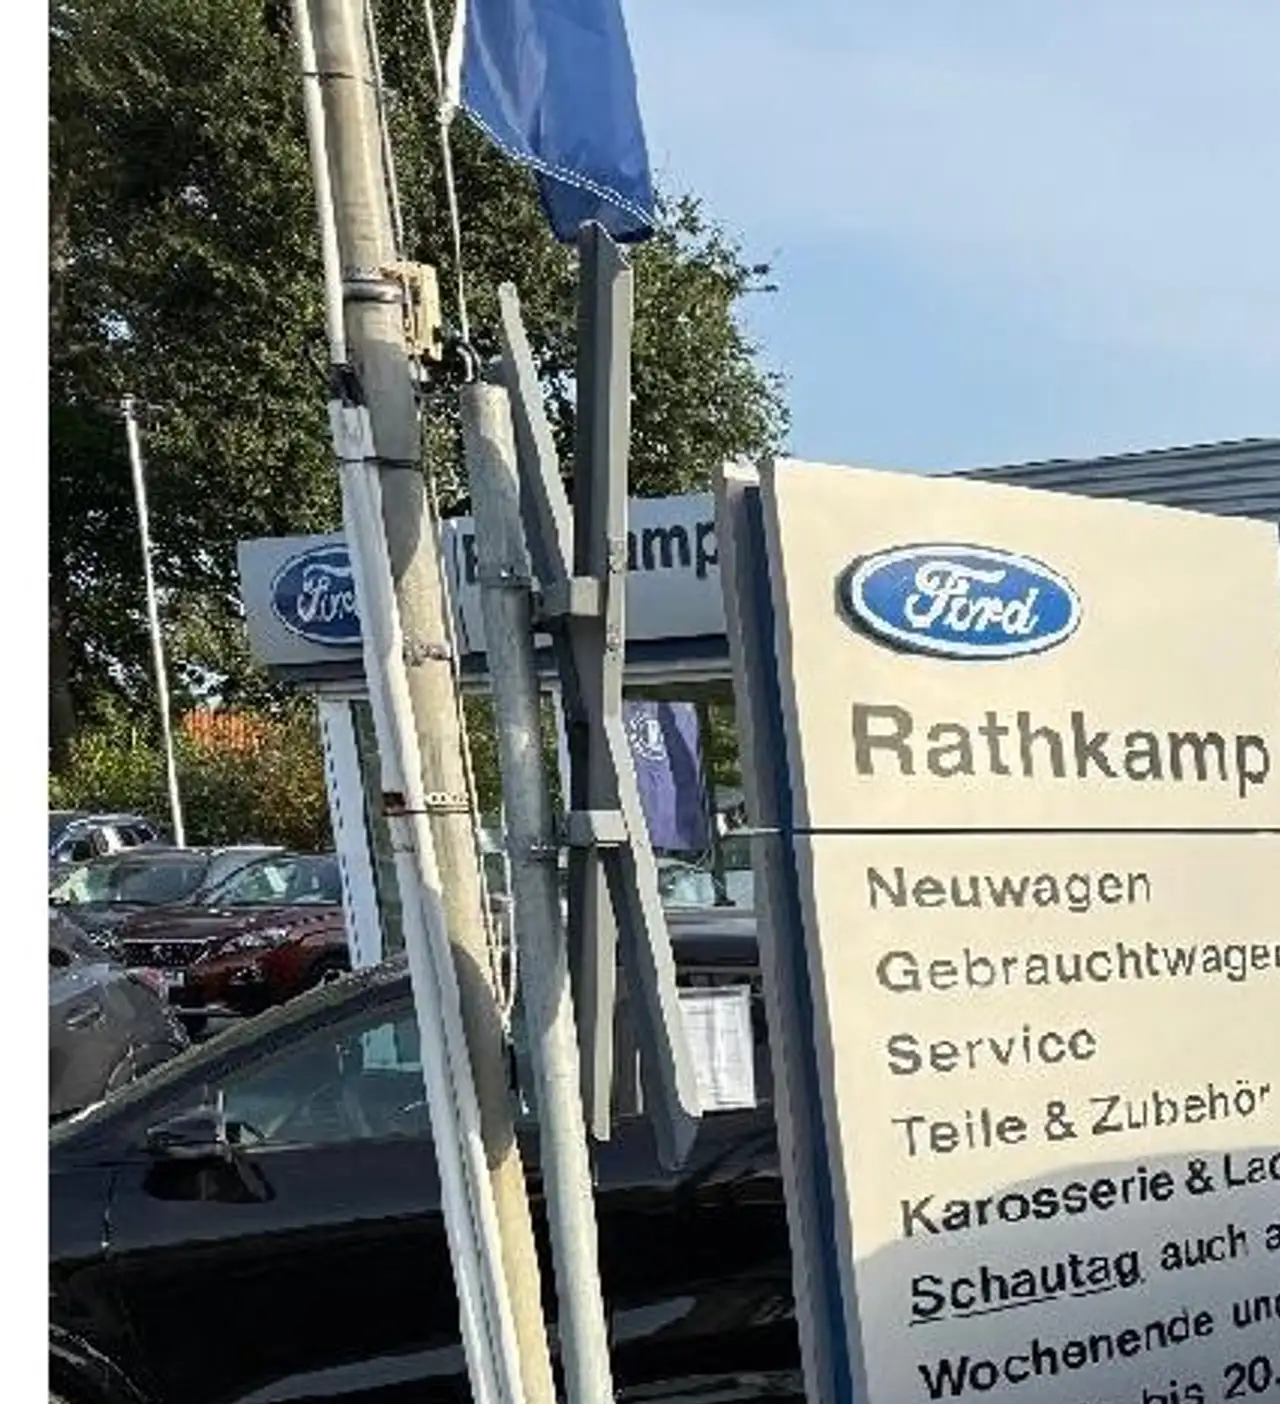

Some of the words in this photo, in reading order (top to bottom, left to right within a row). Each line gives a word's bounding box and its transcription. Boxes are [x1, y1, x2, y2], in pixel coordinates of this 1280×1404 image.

[904, 560, 1041, 636] Ford
[851, 702, 1271, 798] Rathkamp
[867, 866, 1152, 912] Neuwagen
[887, 1023, 1097, 1075] Service
[891, 1107, 1027, 1157] Teile
[1044, 1101, 1078, 1141] &
[1089, 1079, 1270, 1135] Zubehör
[900, 1165, 1175, 1237] Karosserie
[1184, 1158, 1216, 1195] &
[909, 1250, 1142, 1320] Schautag
[1160, 1224, 1247, 1271] auch
[918, 1307, 1214, 1400] Wochenende
